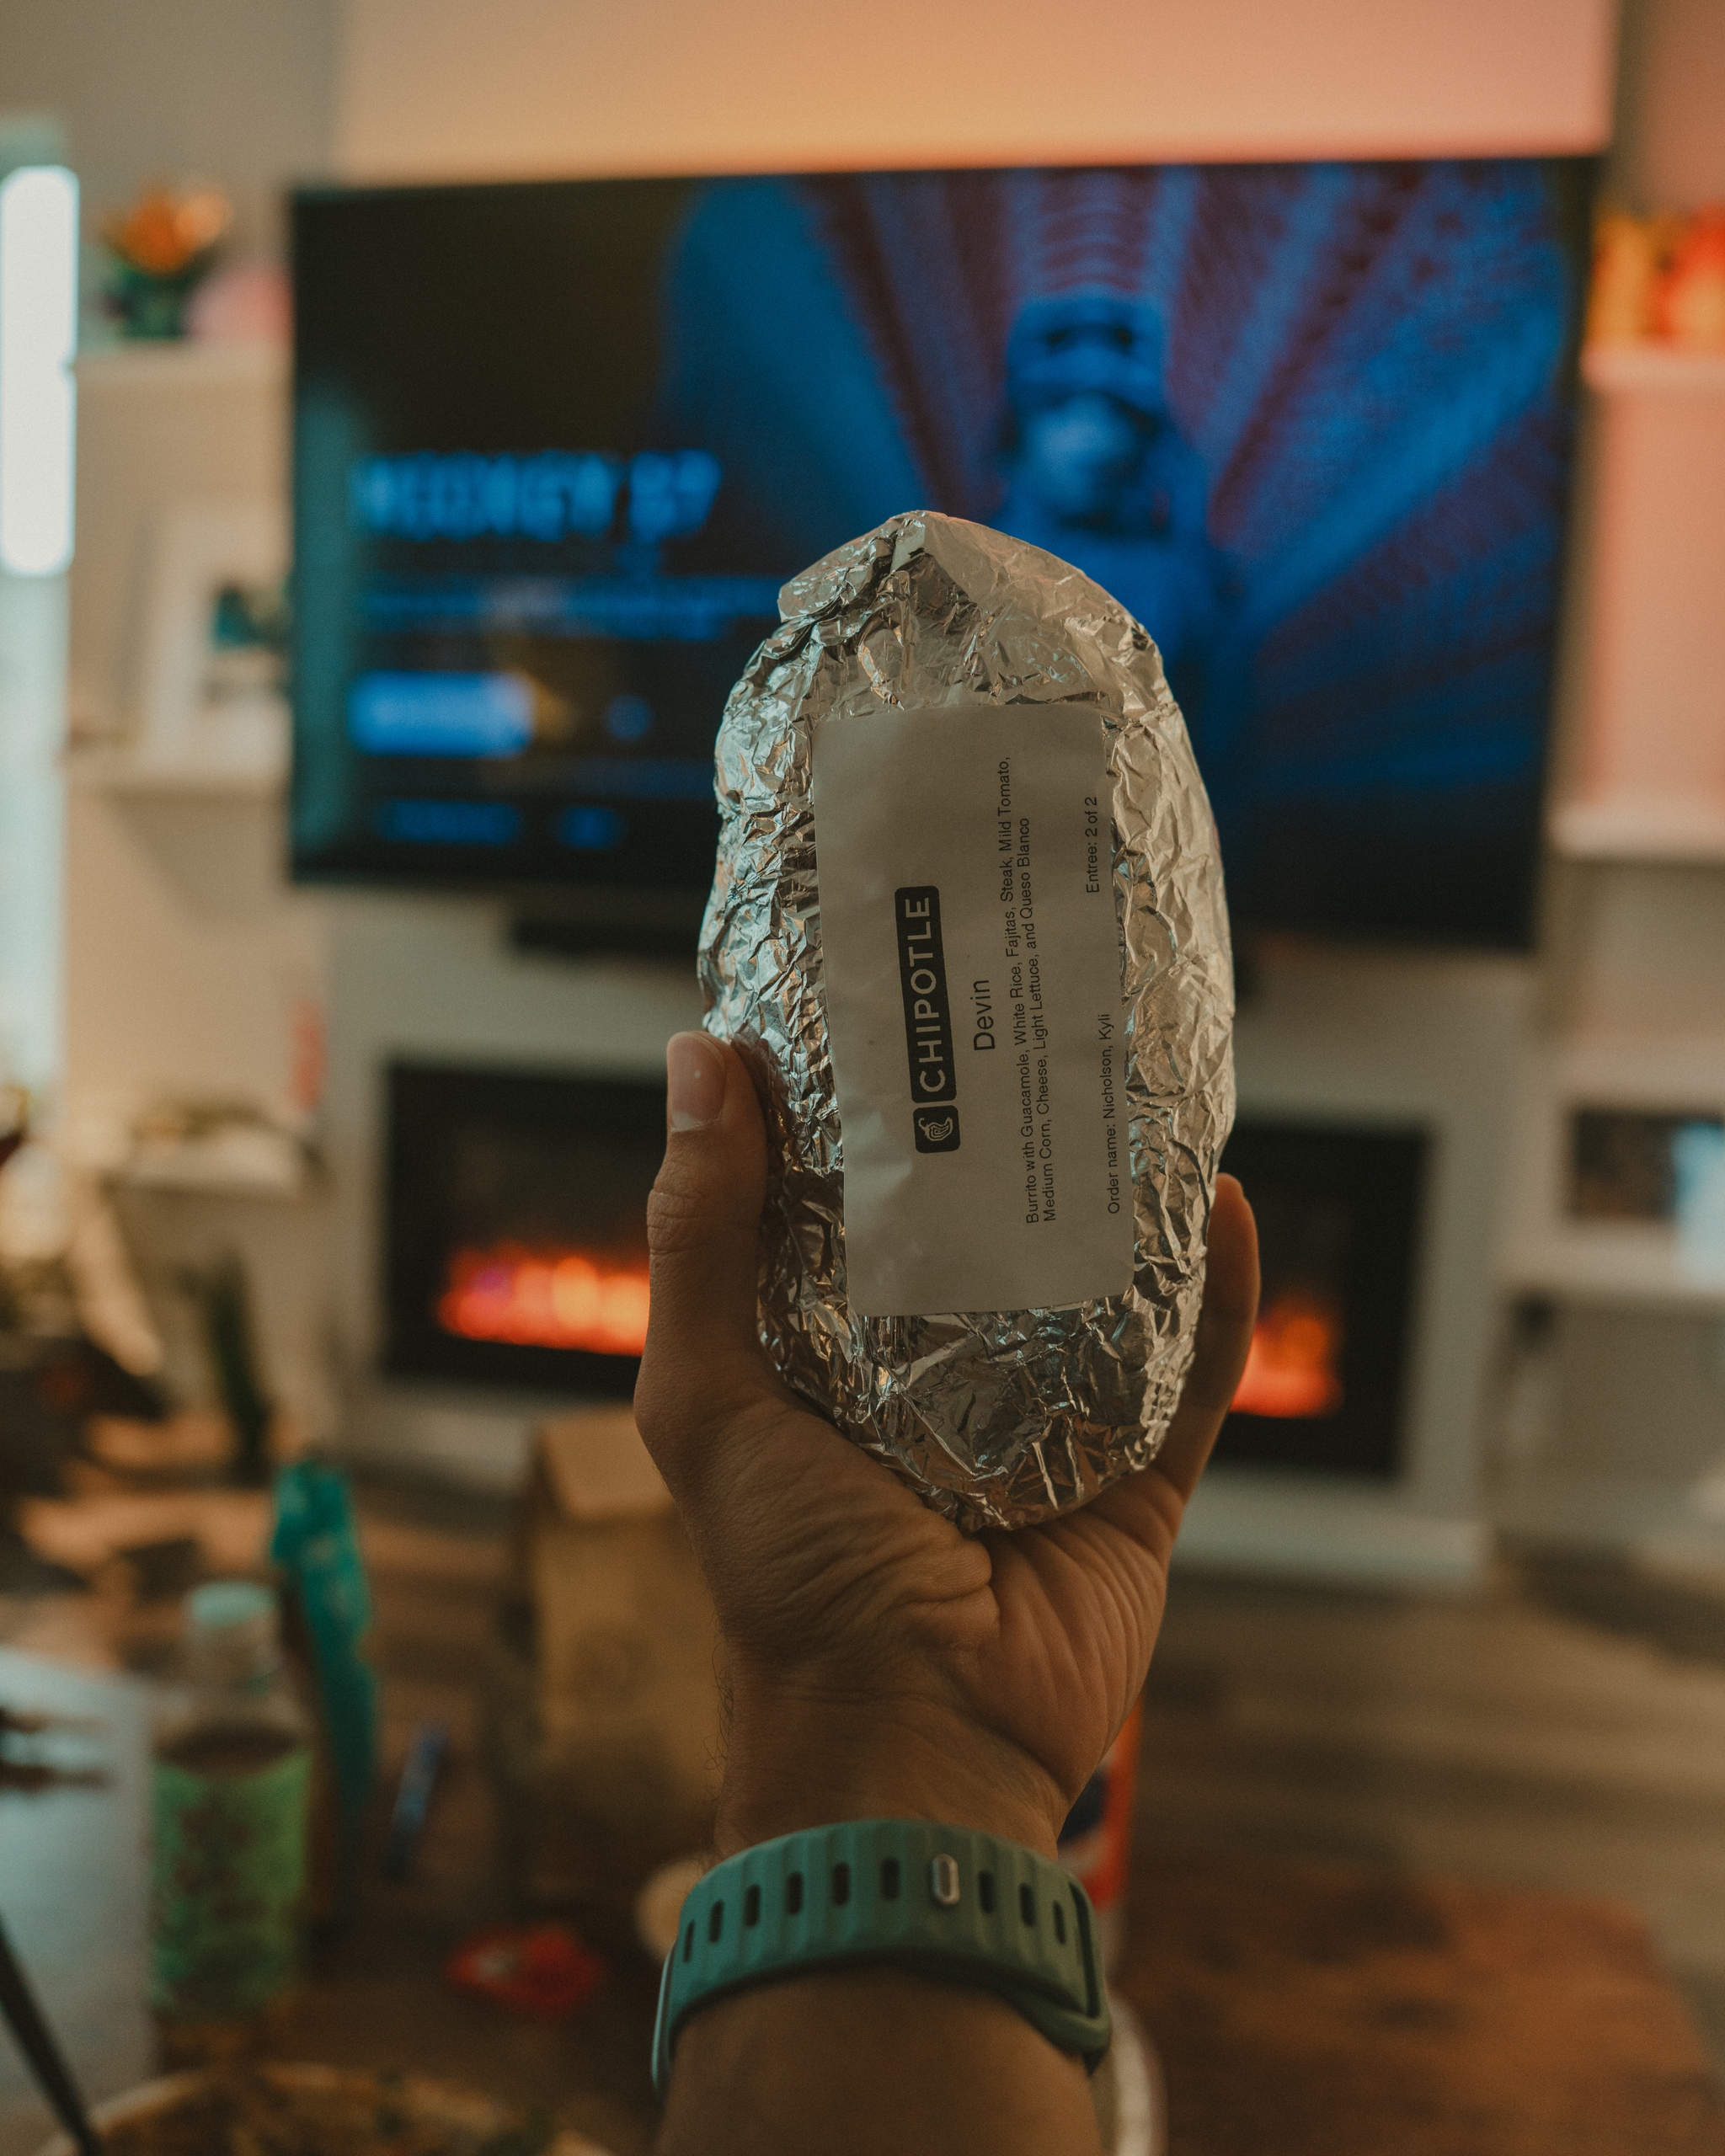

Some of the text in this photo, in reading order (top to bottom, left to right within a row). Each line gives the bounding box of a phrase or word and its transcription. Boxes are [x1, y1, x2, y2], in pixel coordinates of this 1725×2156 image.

[1084, 797, 1100, 894] Entree: 2 of 2
[905, 897, 946, 1092] CHIPOTLE
[970, 979, 996, 1051] Devin
[997, 757, 1039, 1224] Burrito with Guacamole, White Rice, Fajitas, Steak, Mild Tomato,
[1017, 818, 1056, 1222] Medium Corn, Cheese, Light Lettuce, and Queso Blanco
[1097, 1013, 1120, 1214] Order name: Nicholson, Kyli
